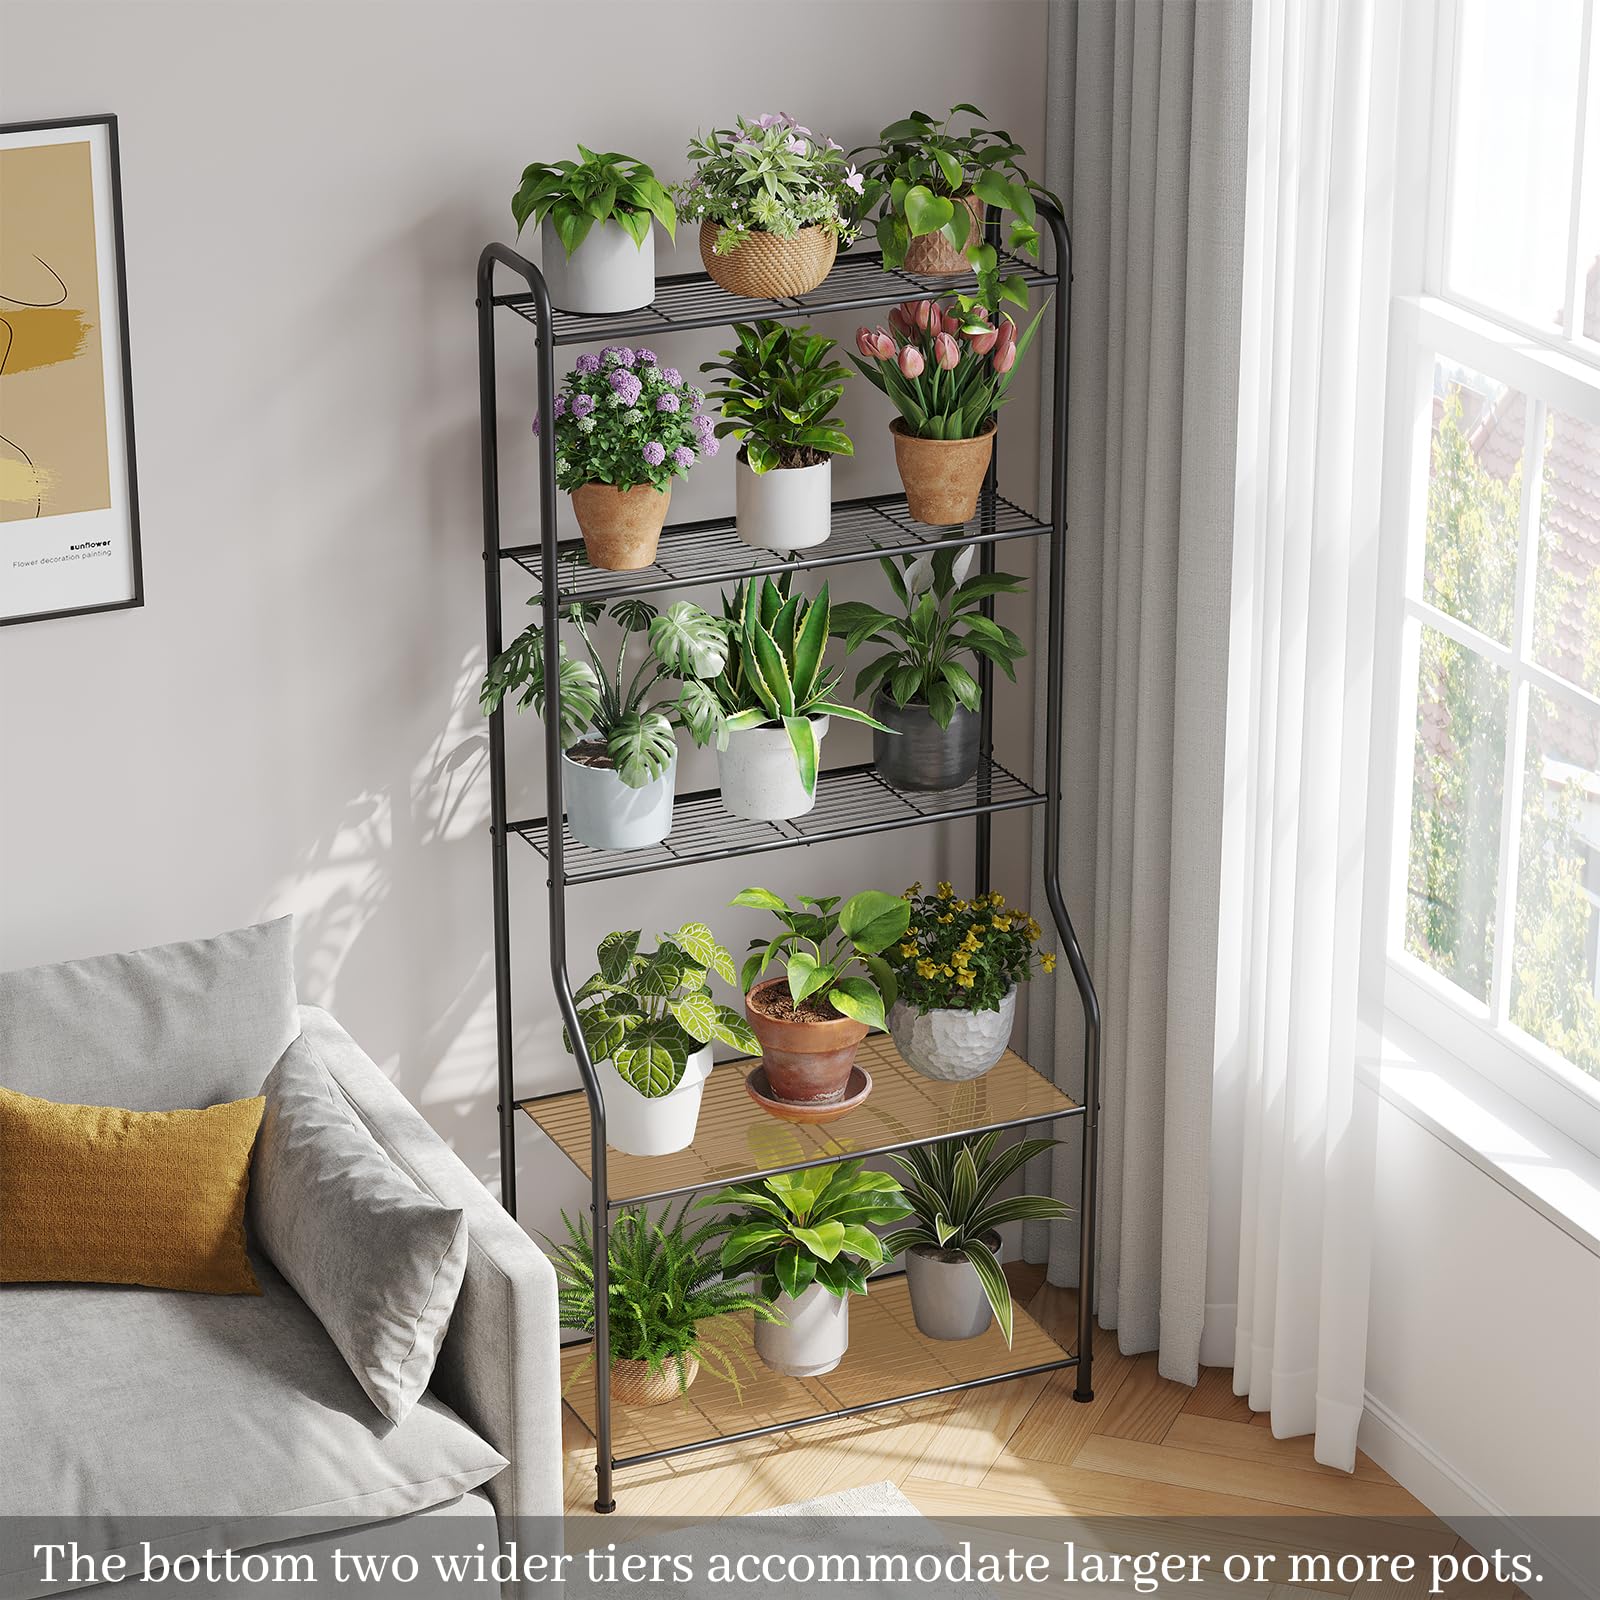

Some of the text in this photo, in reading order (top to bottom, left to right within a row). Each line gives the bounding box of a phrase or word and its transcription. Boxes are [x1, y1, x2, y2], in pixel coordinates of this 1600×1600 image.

[70, 540, 111, 551] sunflower
[12, 549, 112, 569] Flower decoration painting
